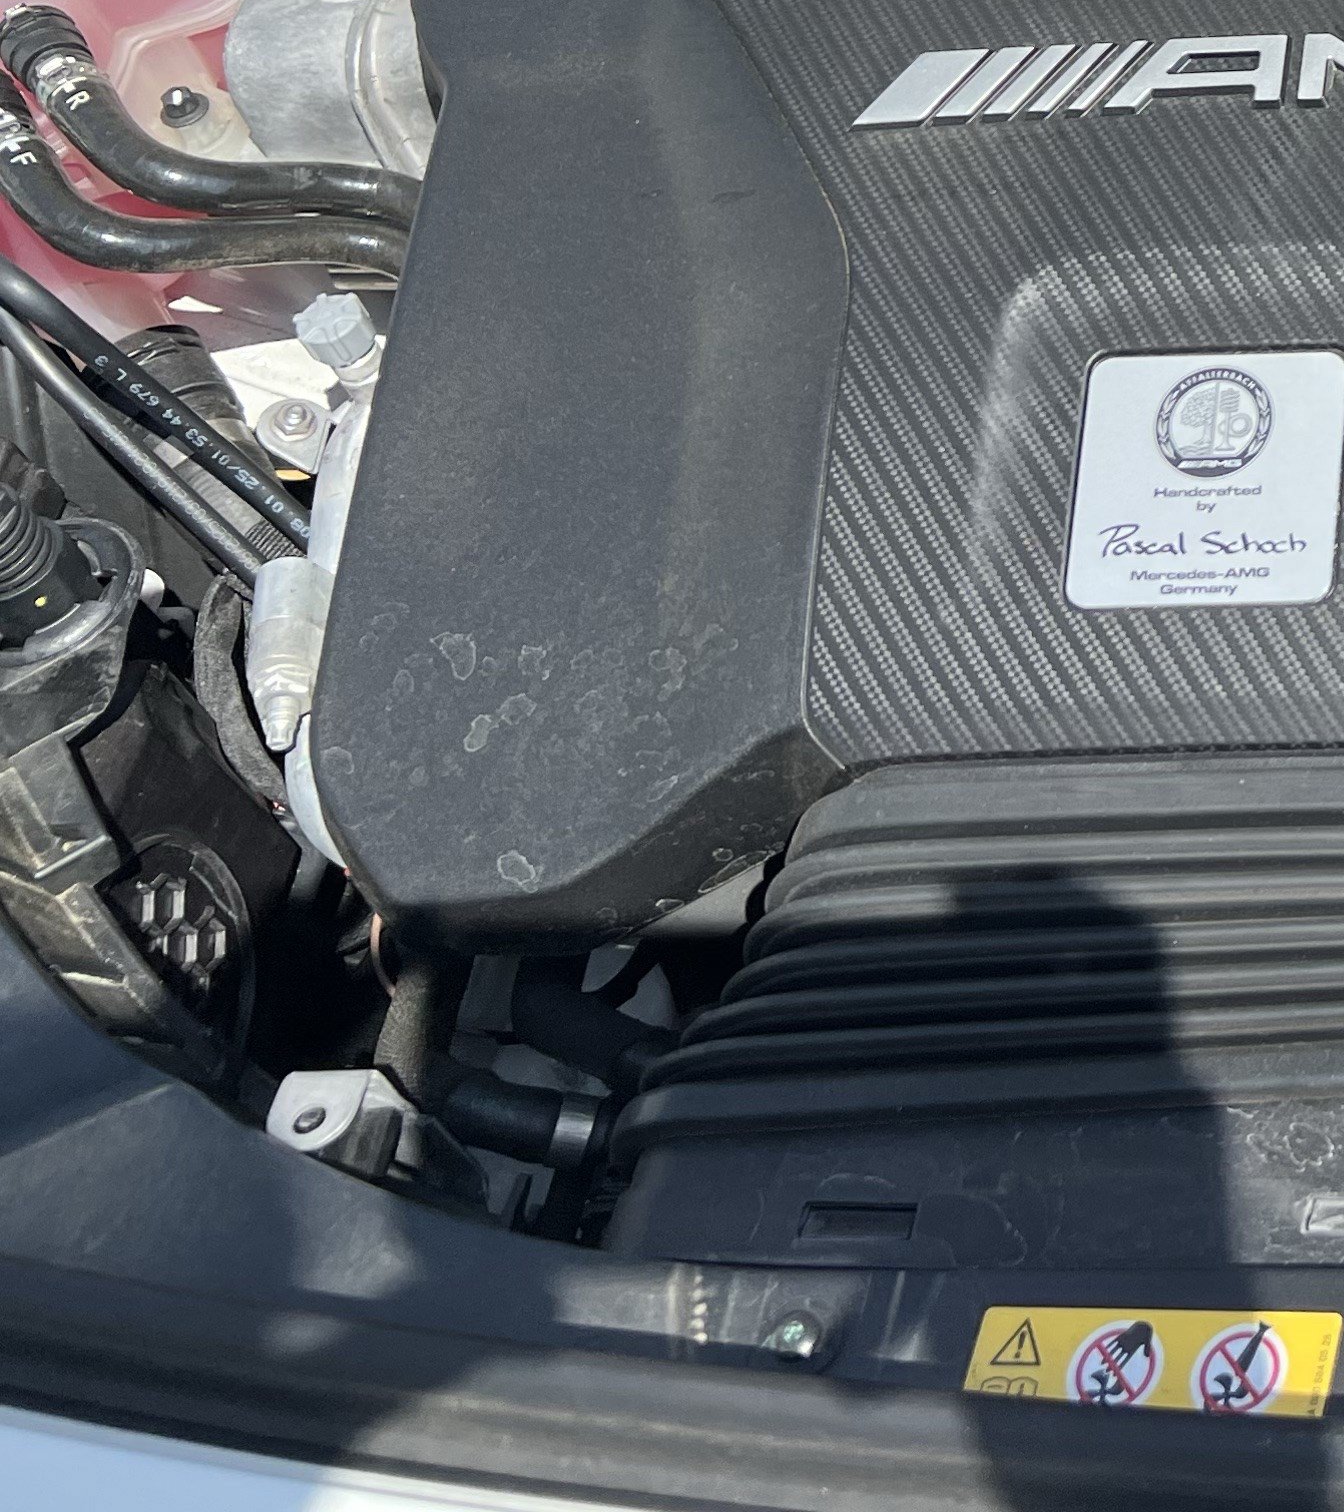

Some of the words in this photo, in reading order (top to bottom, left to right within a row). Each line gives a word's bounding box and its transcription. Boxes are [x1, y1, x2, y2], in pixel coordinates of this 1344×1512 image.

[66, 90, 91, 111] R
[10, 151, 38, 165] F
[94, 355, 109, 367] 3
[116, 367, 128, 382] L
[129, 382, 160, 407] 679
[1153, 485, 1263, 499] Handcrafted
[1196, 500, 1217, 514] by
[1097, 523, 1187, 559] Pascal
[1129, 567, 1270, 582] Mercedes-AMG
[1159, 584, 1239, 597] Germany
